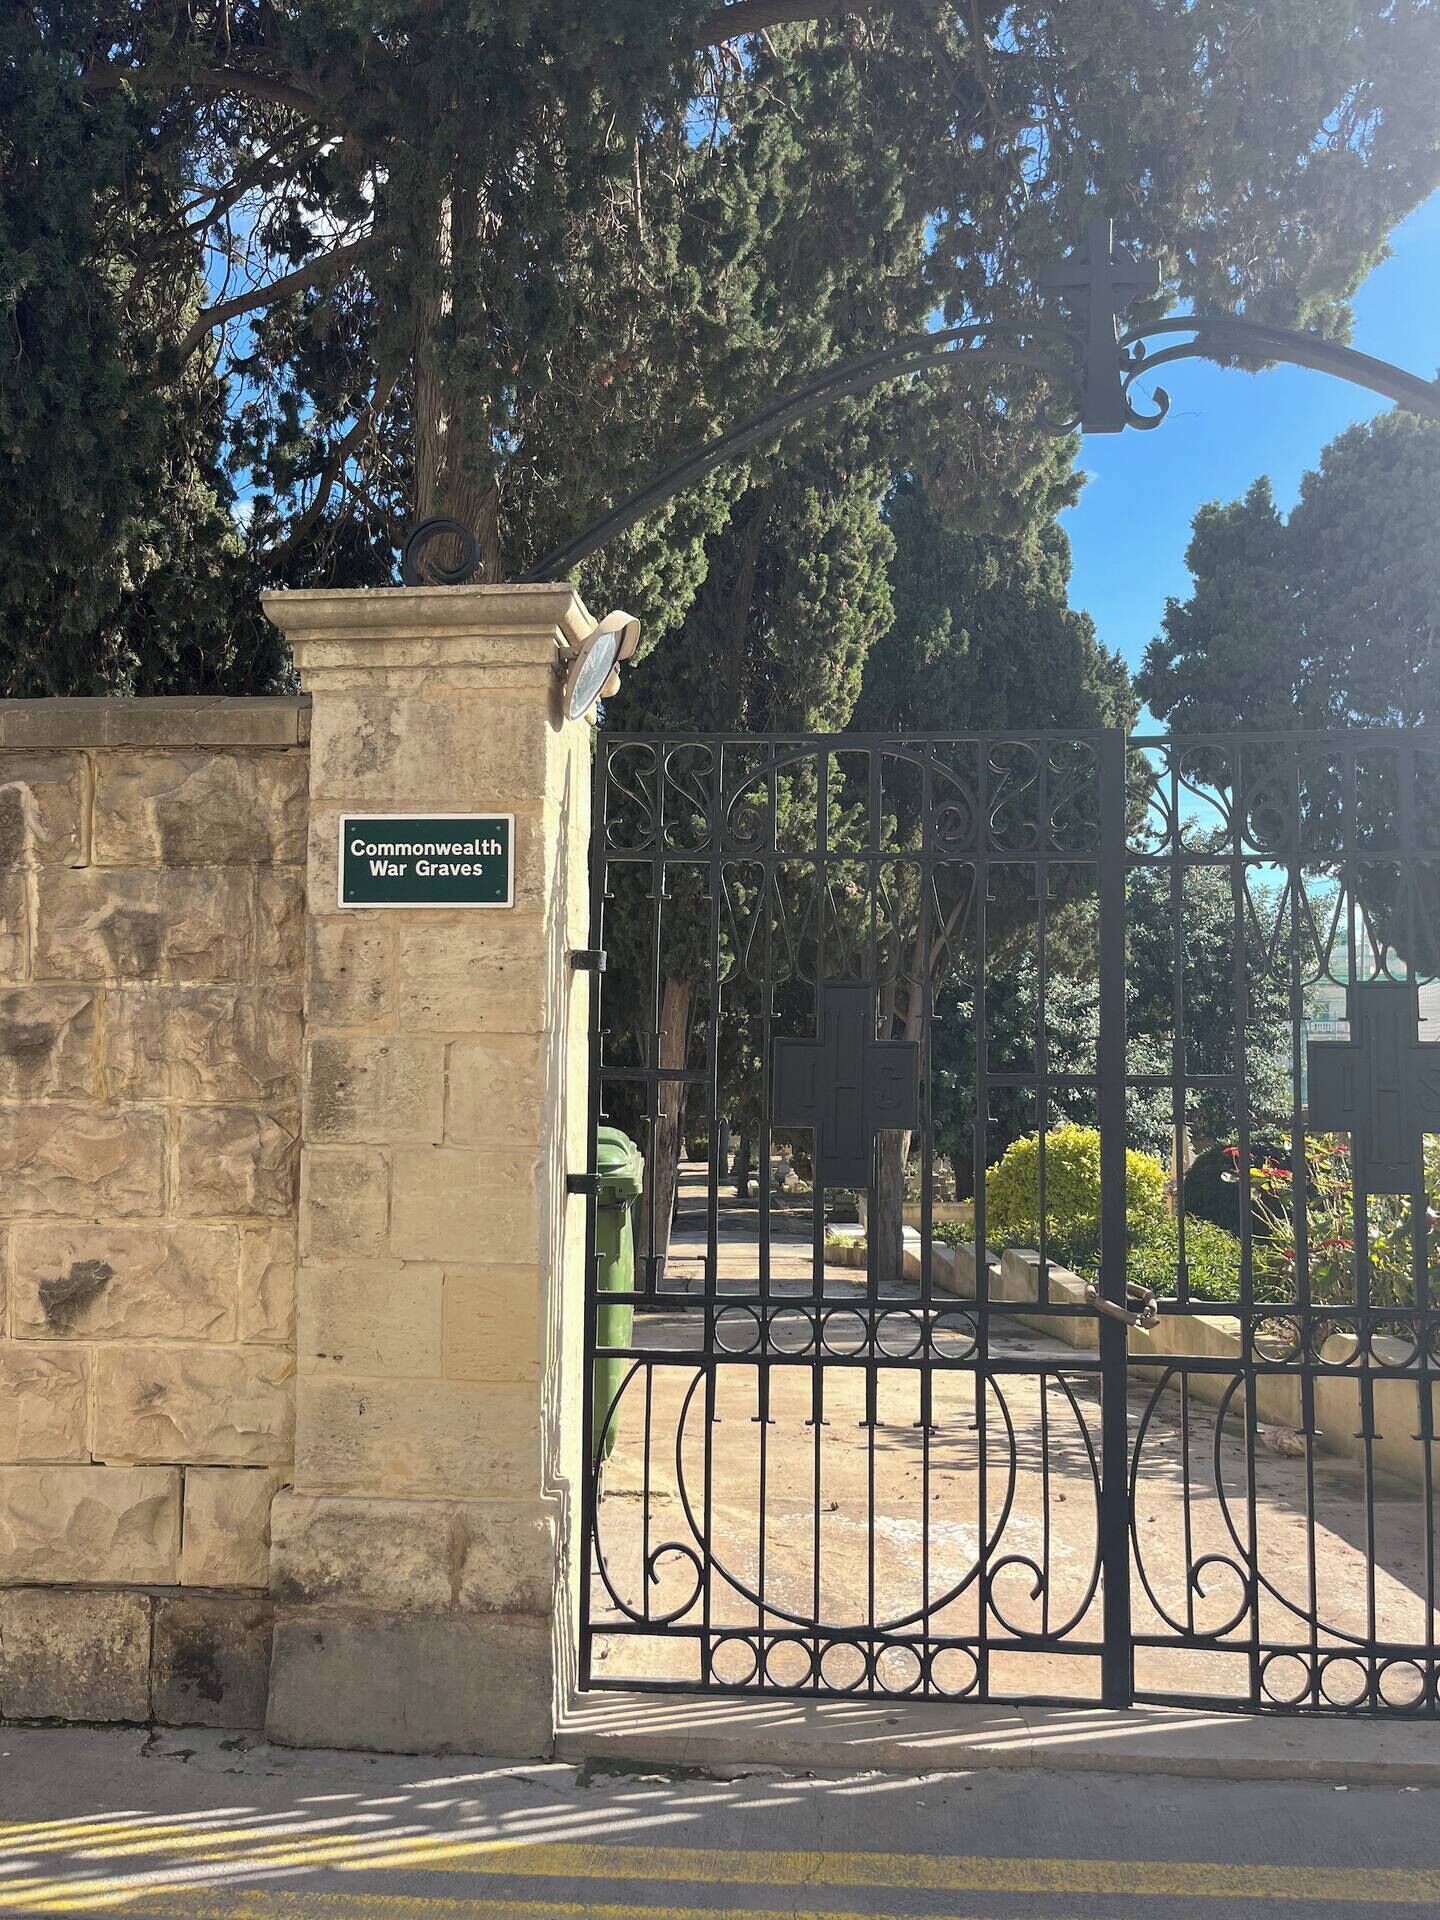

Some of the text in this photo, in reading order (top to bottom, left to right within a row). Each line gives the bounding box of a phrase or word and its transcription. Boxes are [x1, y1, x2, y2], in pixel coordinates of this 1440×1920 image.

[351, 839, 502, 856] Commonwealth
[370, 860, 483, 876] War Graves
